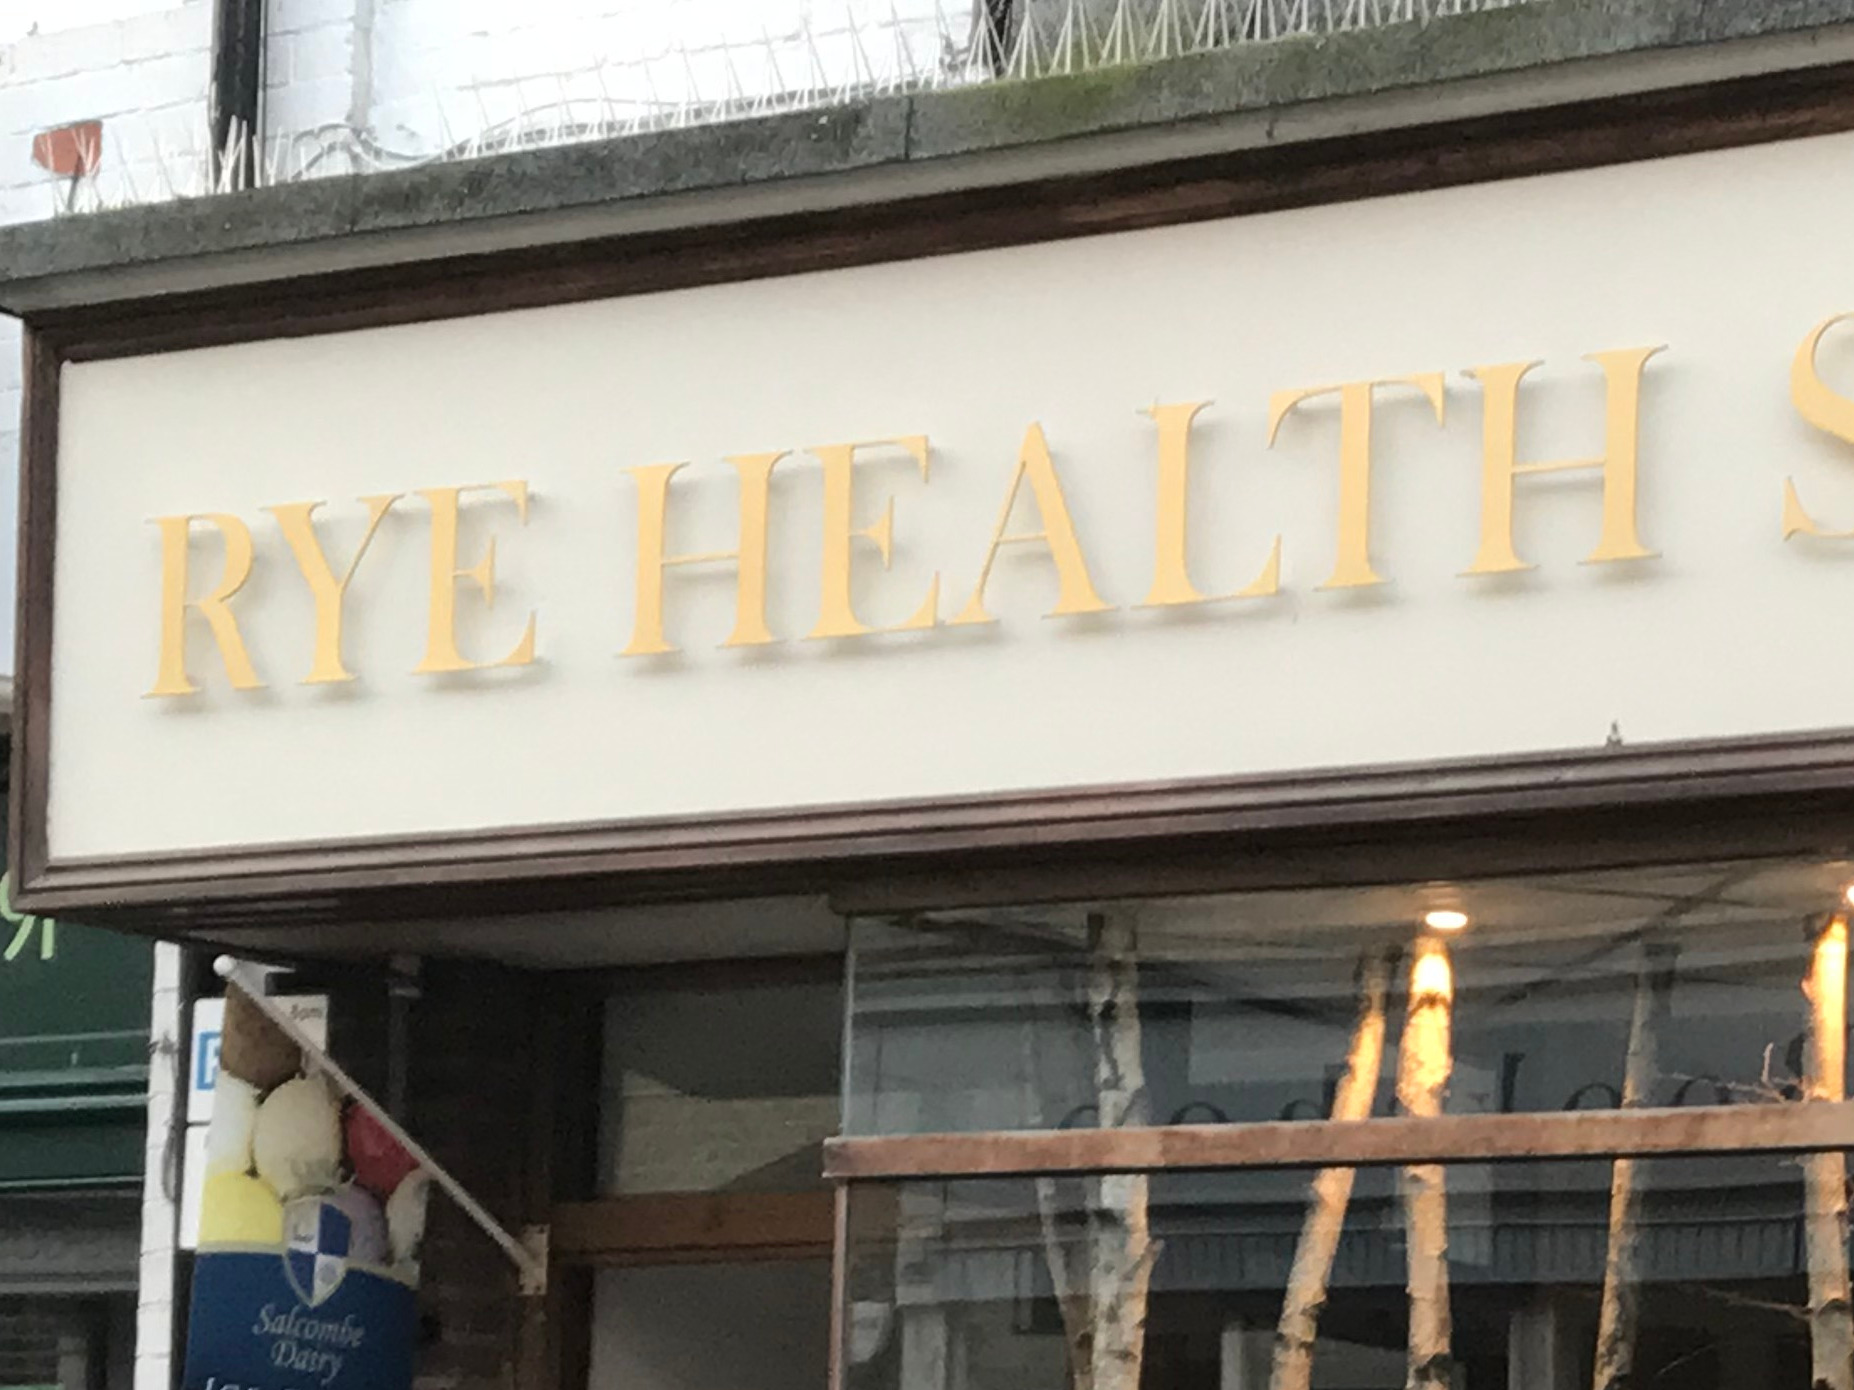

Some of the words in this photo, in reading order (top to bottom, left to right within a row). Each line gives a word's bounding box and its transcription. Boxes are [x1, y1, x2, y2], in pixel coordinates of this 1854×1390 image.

[141, 479, 538, 699] RYE
[617, 345, 1668, 656] HEALTH
[253, 1303, 366, 1348] Salcombe
[270, 1340, 344, 1386] Dairy
